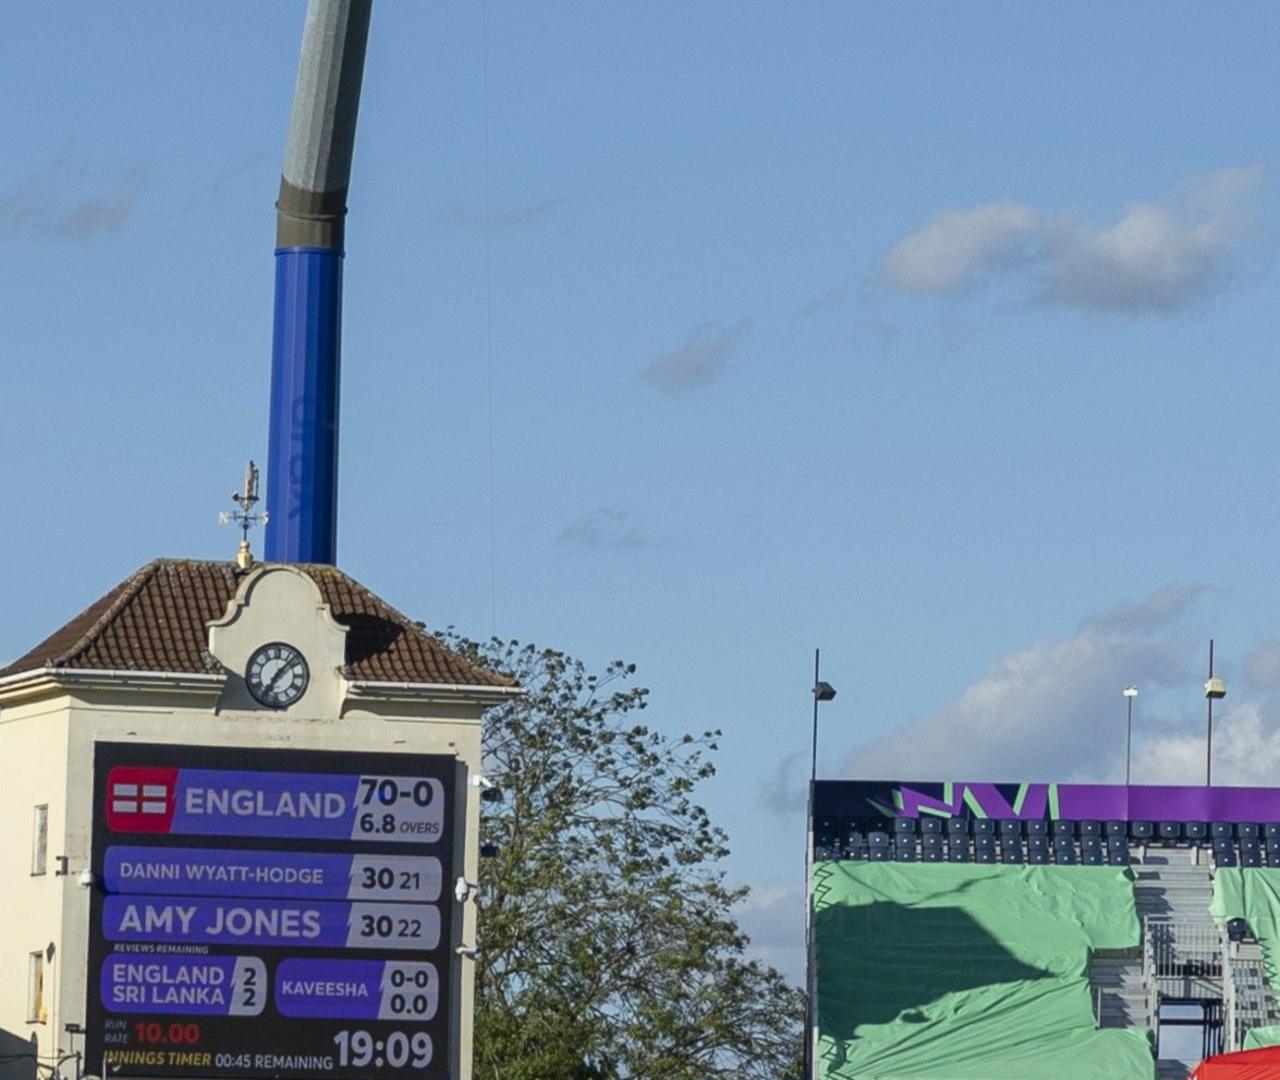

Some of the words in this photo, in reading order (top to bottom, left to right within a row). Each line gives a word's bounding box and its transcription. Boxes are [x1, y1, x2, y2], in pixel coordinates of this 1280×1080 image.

[185, 788, 346, 820] ENGLAND
[360, 778, 434, 808] 70-0
[359, 813, 396, 835] 6.8
[400, 821, 440, 834] OVERS
[119, 862, 180, 879] DANNI
[186, 865, 324, 884] WYATT-HODGE
[362, 867, 394, 890] 30
[399, 872, 421, 890] 21
[119, 905, 196, 934] AMY
[206, 908, 321, 938] JONES
[360, 914, 393, 938] 30
[397, 919, 422, 938] 22
[114, 943, 155, 953] REVIEWS
[156, 944, 209, 954] REMAINING
[113, 964, 225, 985] ENGLAND
[243, 968, 256, 986] 2
[391, 969, 428, 988] 0-0
[113, 985, 146, 1003] SRI
[152, 987, 225, 1005] LANKA
[243, 988, 256, 1006] 2
[282, 981, 369, 998] KAVEESHA
[391, 995, 428, 1014] 0.0
[134, 1023, 201, 1044] 10.00
[104, 1050, 164, 1065] INNINGS
[168, 1052, 212, 1066] TIMER
[215, 1053, 252, 1068] 00:45
[254, 1054, 333, 1070] REMAINING
[334, 1030, 434, 1069] 19:09
